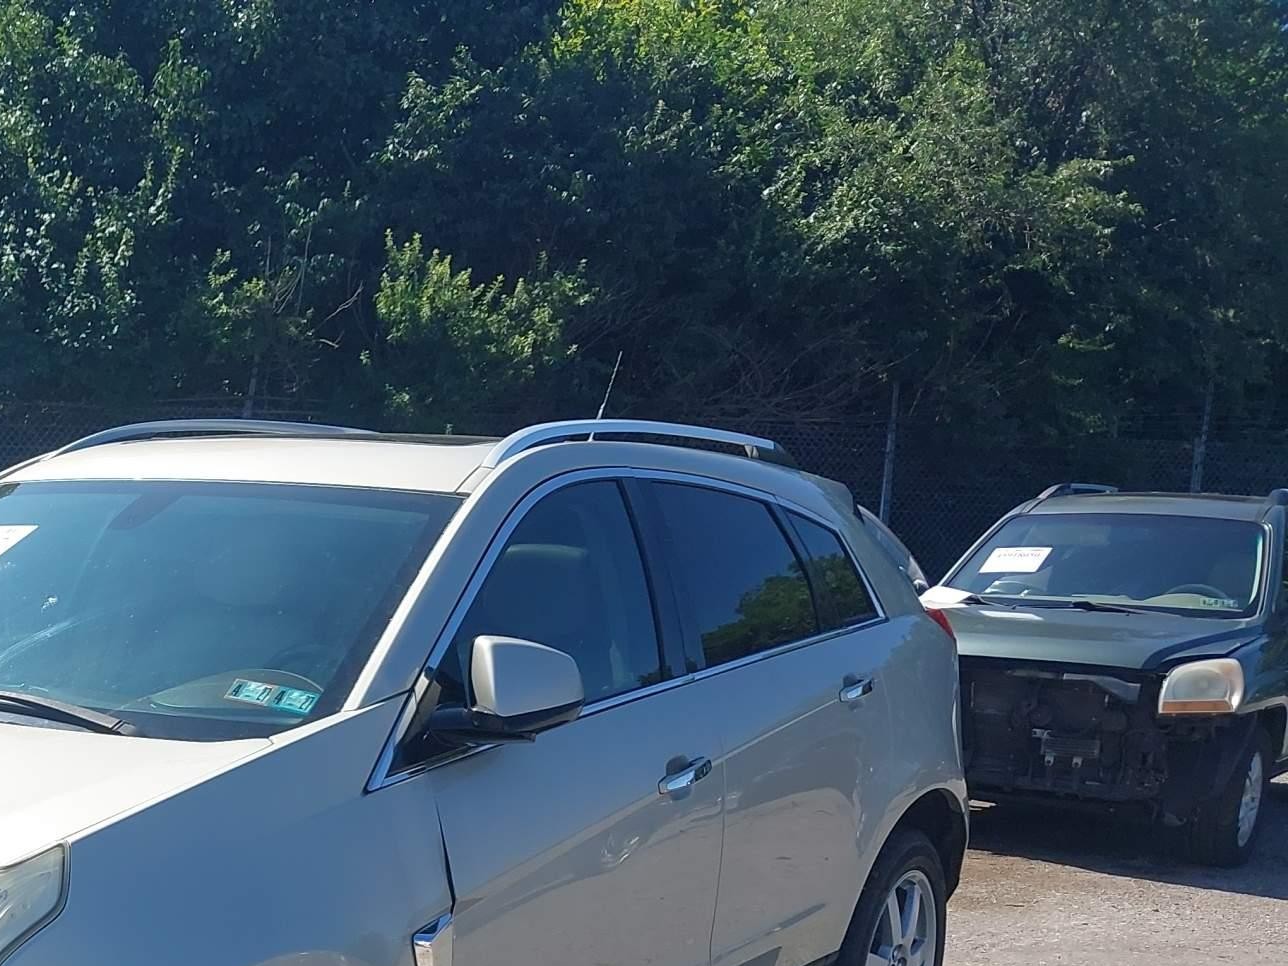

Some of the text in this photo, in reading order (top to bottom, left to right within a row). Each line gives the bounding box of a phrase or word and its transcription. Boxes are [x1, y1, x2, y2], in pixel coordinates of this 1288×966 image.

[232, 683, 244, 697] 4
[274, 689, 316, 711] 4 27
